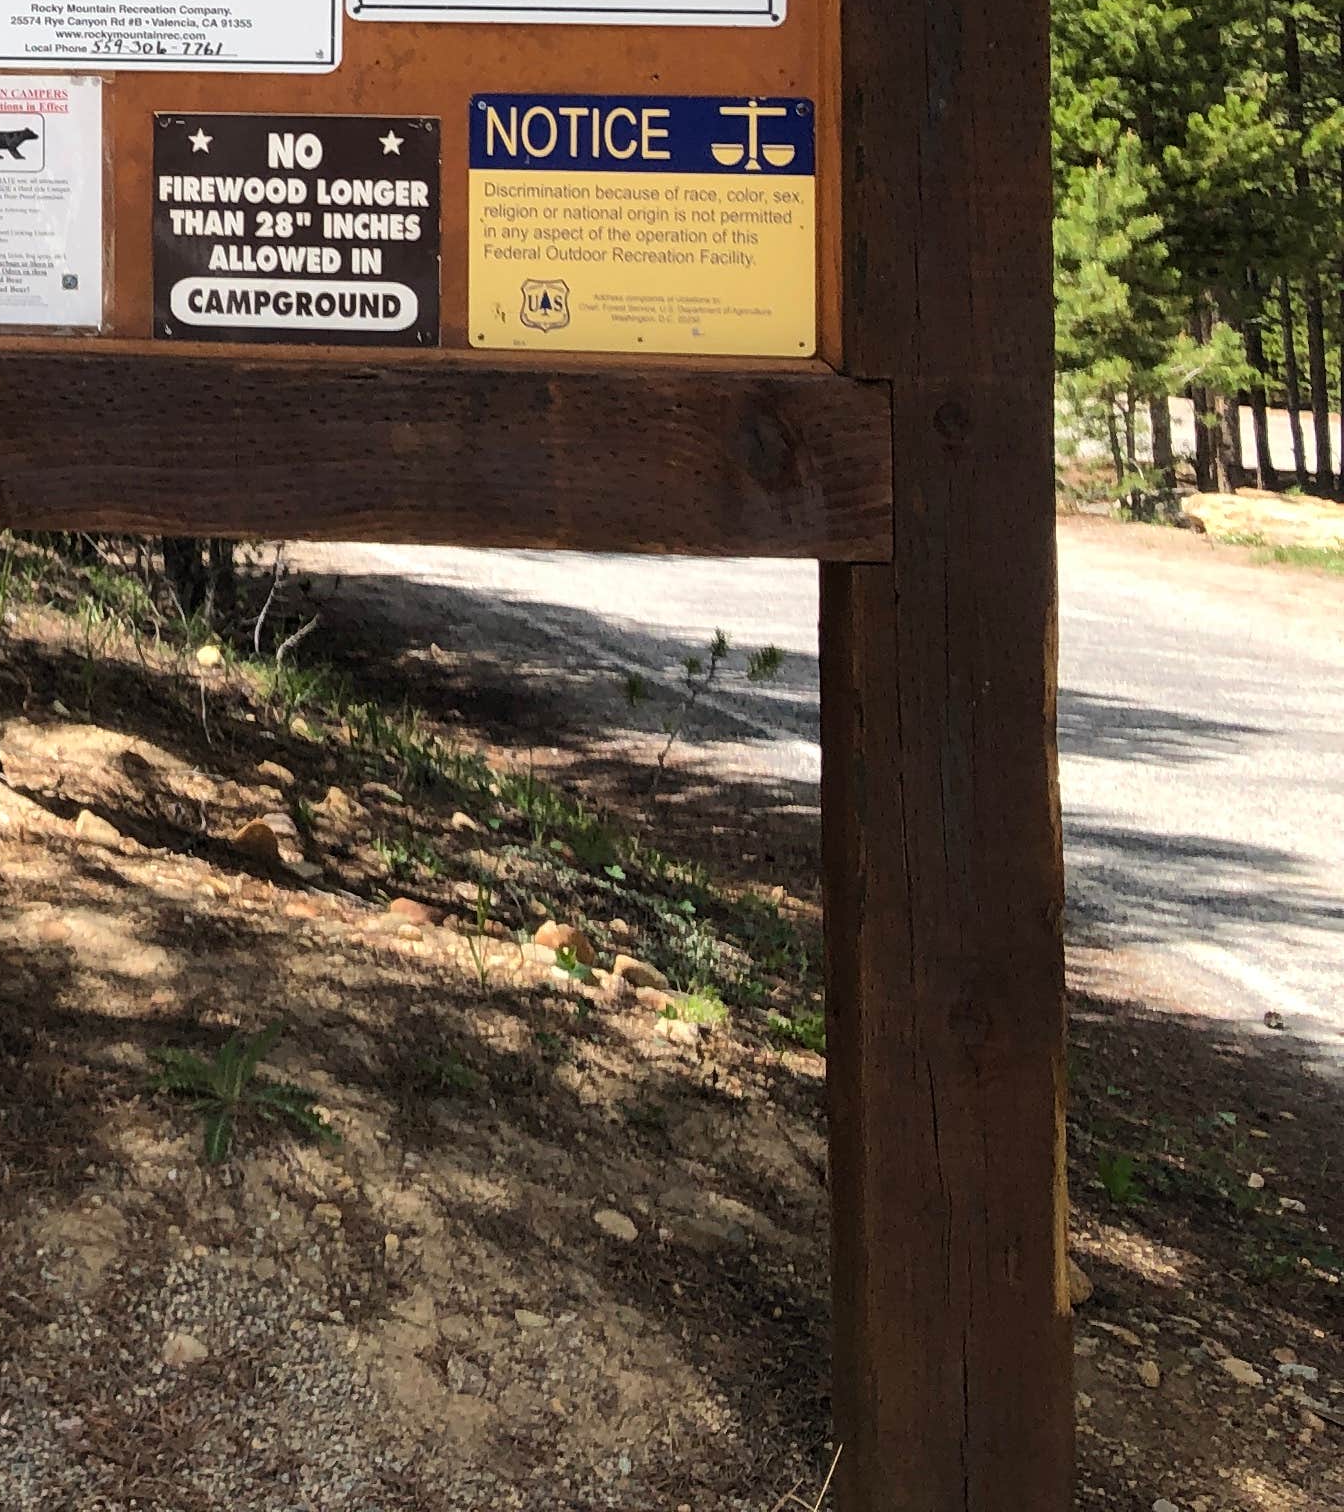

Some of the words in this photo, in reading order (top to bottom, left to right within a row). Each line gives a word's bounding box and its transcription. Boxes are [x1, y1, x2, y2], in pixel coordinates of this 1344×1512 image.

[30, 3, 64, 17] Rocky
[66, 3, 115, 18] Mountain
[118, 4, 176, 14] Recreation
[24, 43, 52, 52] Local
[54, 43, 87, 53] Phone
[54, 29, 206, 42] www.rockymountainrec.com
[11, 89, 69, 98] CAMPERS
[26, 102, 35, 111] in
[40, 102, 69, 111] Effect
[482, 103, 670, 159] NOTICE
[268, 132, 322, 169] NO
[159, 175, 307, 204] FIREWOOD
[317, 178, 429, 207] LONGER
[484, 181, 590, 199] Discrimination
[595, 183, 660, 200] because
[664, 185, 680, 201] of
[683, 189, 721, 204] race,
[726, 186, 767, 205] color,
[169, 208, 244, 236] THAN
[255, 210, 311, 237] 28"
[323, 212, 421, 240] INCHES
[208, 244, 341, 273] ALLOWED
[351, 247, 381, 274] IN
[188, 288, 401, 318] CAMPGROUND
